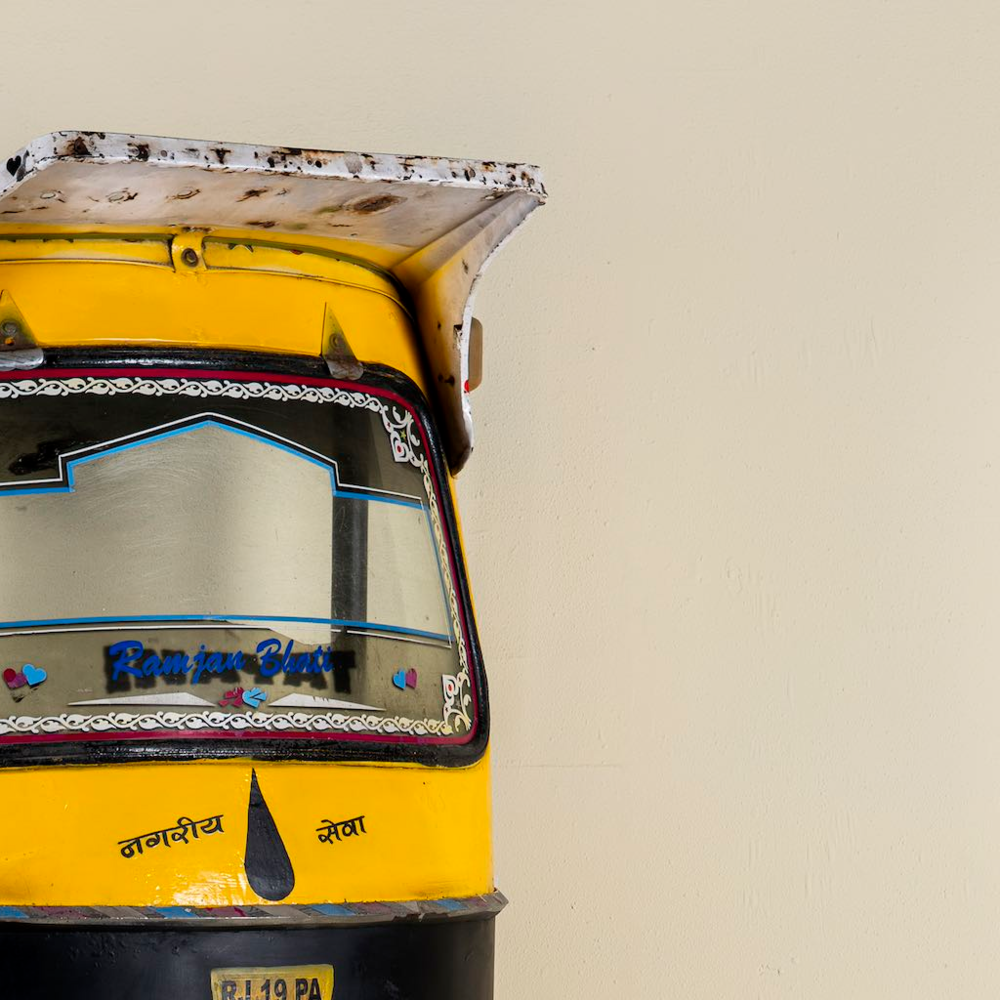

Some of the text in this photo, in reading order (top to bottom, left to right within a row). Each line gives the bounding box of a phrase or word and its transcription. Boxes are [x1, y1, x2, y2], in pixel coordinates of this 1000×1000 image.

[108, 640, 247, 685] Ramjan
[118, 814, 368, 859] नगरीय सेवा
